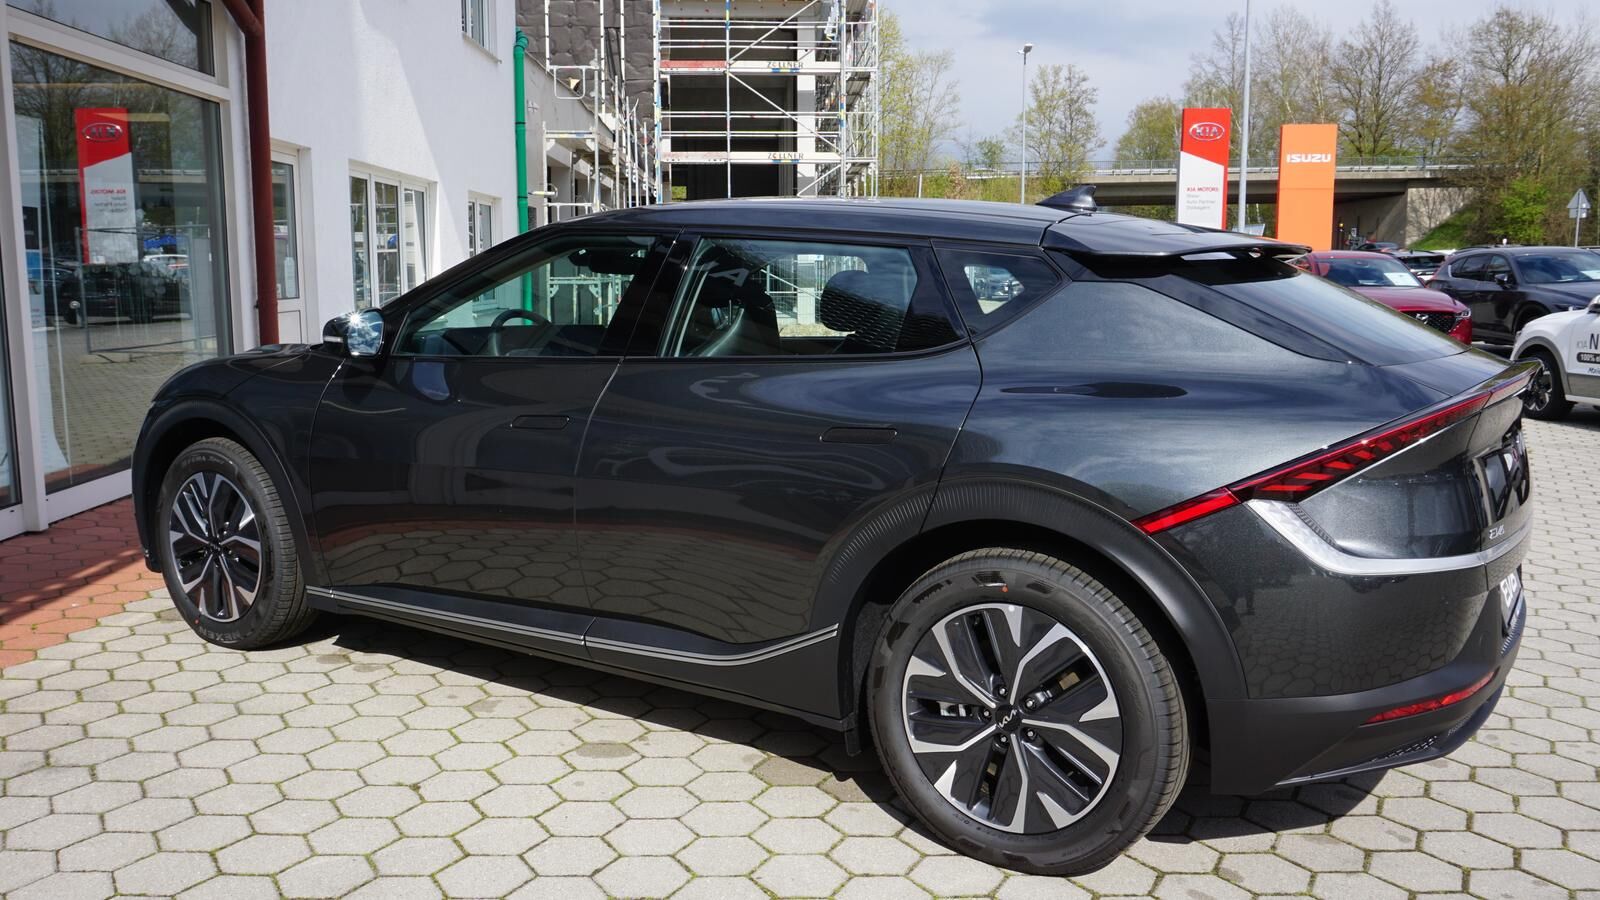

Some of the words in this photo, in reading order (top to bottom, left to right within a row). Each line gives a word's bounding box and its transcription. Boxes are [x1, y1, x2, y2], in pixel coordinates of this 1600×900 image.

[1286, 153, 1331, 163] ISUZU
[1580, 353, 1595, 362] 100%
[1499, 573, 1517, 609] EV6
